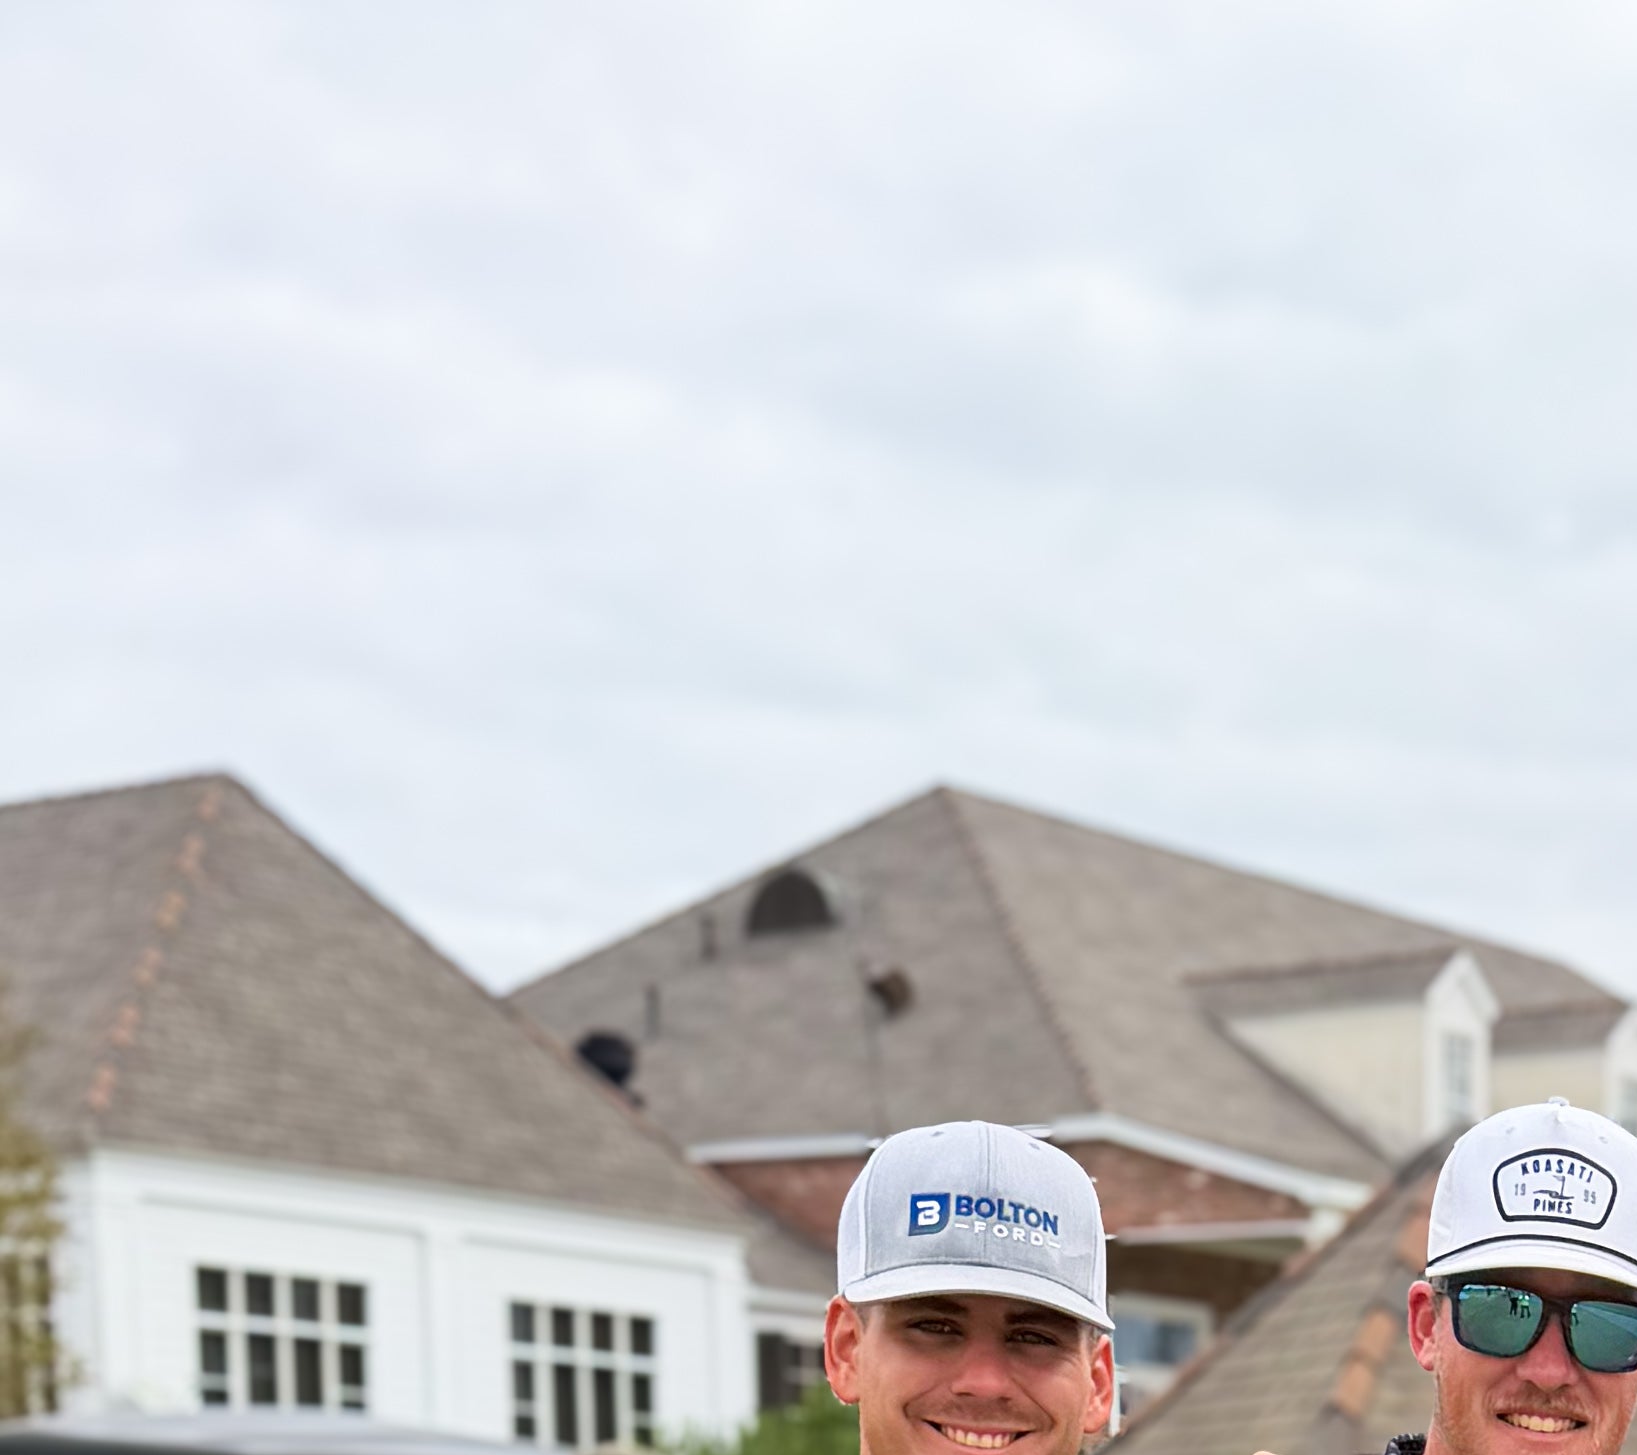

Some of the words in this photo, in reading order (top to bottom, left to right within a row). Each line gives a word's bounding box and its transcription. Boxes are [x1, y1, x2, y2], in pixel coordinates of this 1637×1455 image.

[1520, 1158, 1593, 1183] KOASATI
[954, 1194, 1059, 1236] BOLTON
[1533, 1198, 1573, 1215] PINES
